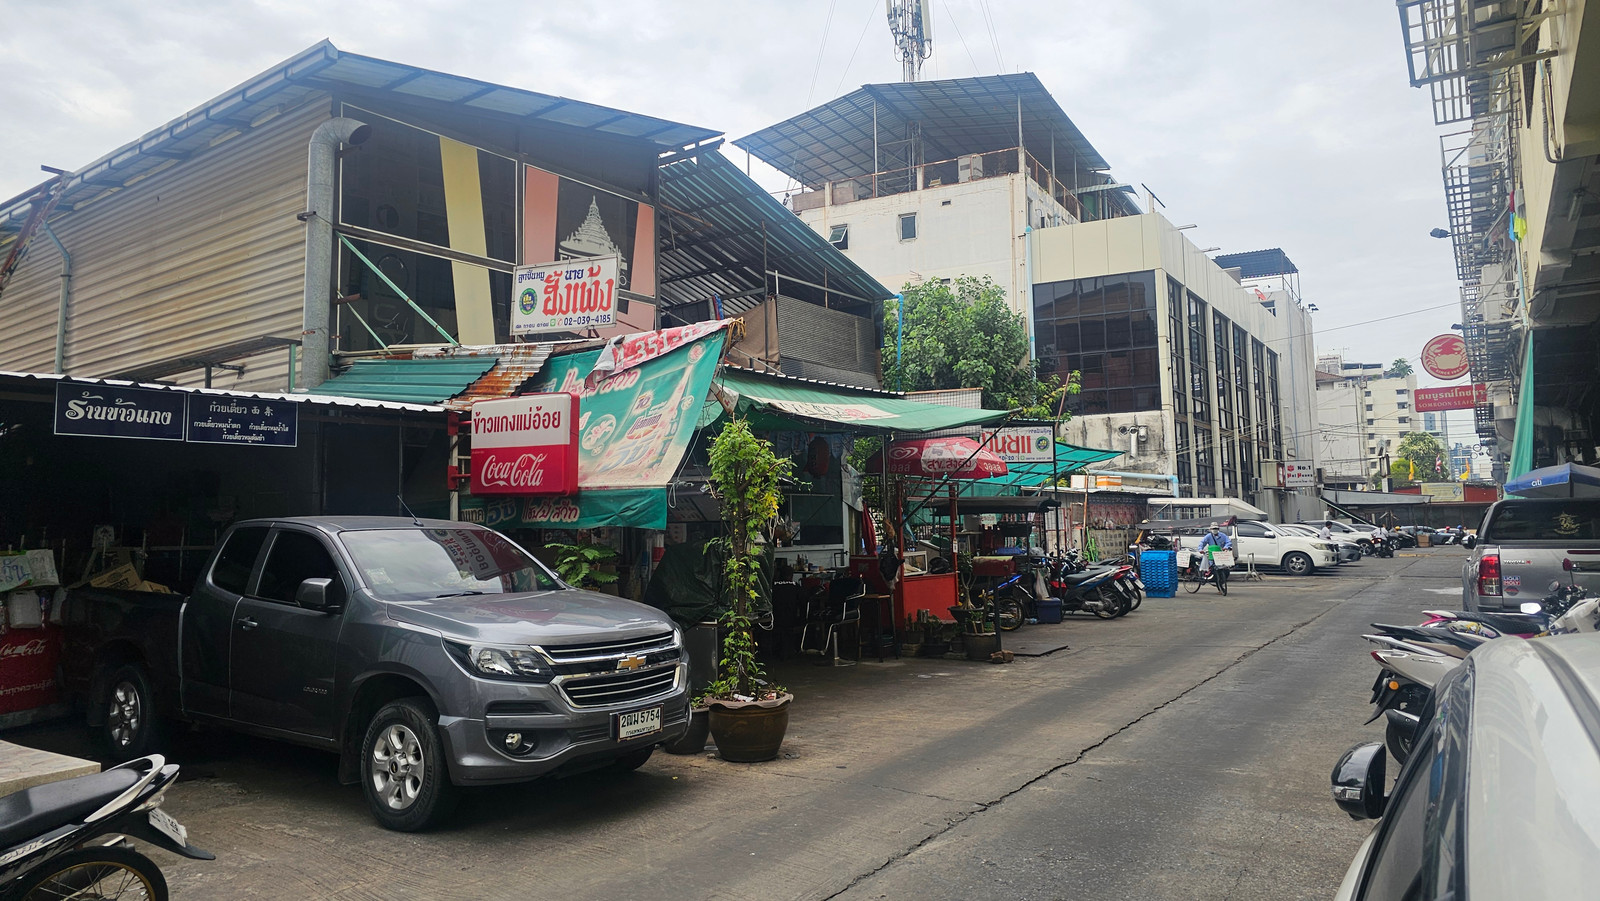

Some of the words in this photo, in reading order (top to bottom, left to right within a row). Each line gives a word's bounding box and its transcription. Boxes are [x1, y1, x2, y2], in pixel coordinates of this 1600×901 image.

[564, 269, 584, 280] นาย
[564, 314, 610, 326] 02-039-4185
[65, 391, 172, 425] ร้านข้าวแกง
[474, 406, 561, 434] ข้าวแกงแม่อ้อย
[640, 708, 660, 724] 5754
